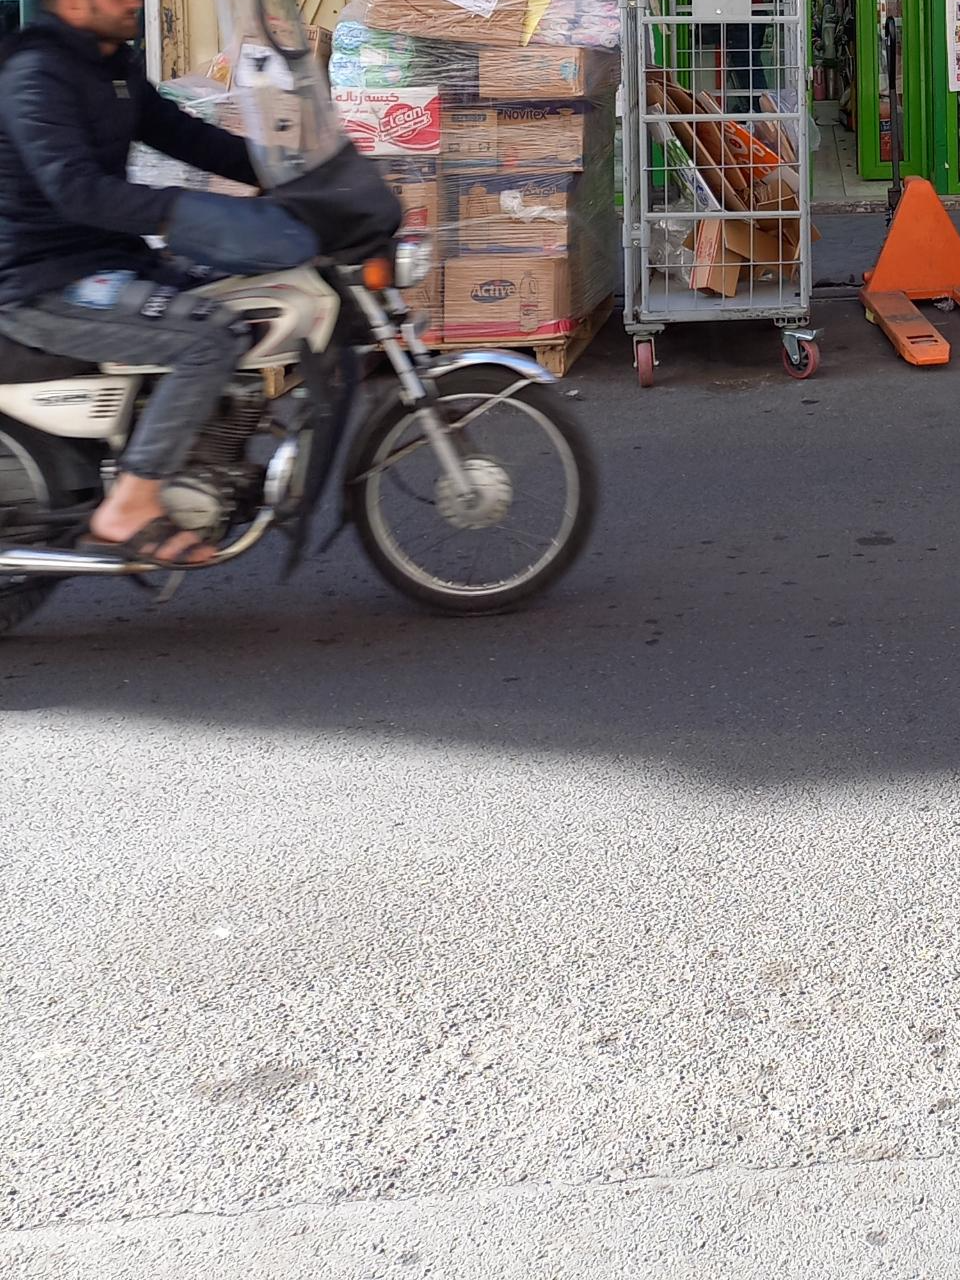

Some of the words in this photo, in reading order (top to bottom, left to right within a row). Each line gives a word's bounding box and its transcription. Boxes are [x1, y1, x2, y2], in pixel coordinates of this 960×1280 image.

[335, 91, 363, 105] زباله
[364, 92, 400, 105] کیسه
[378, 107, 423, 133] Clean
[503, 109, 549, 121] Novitex
[472, 284, 517, 297] Active
